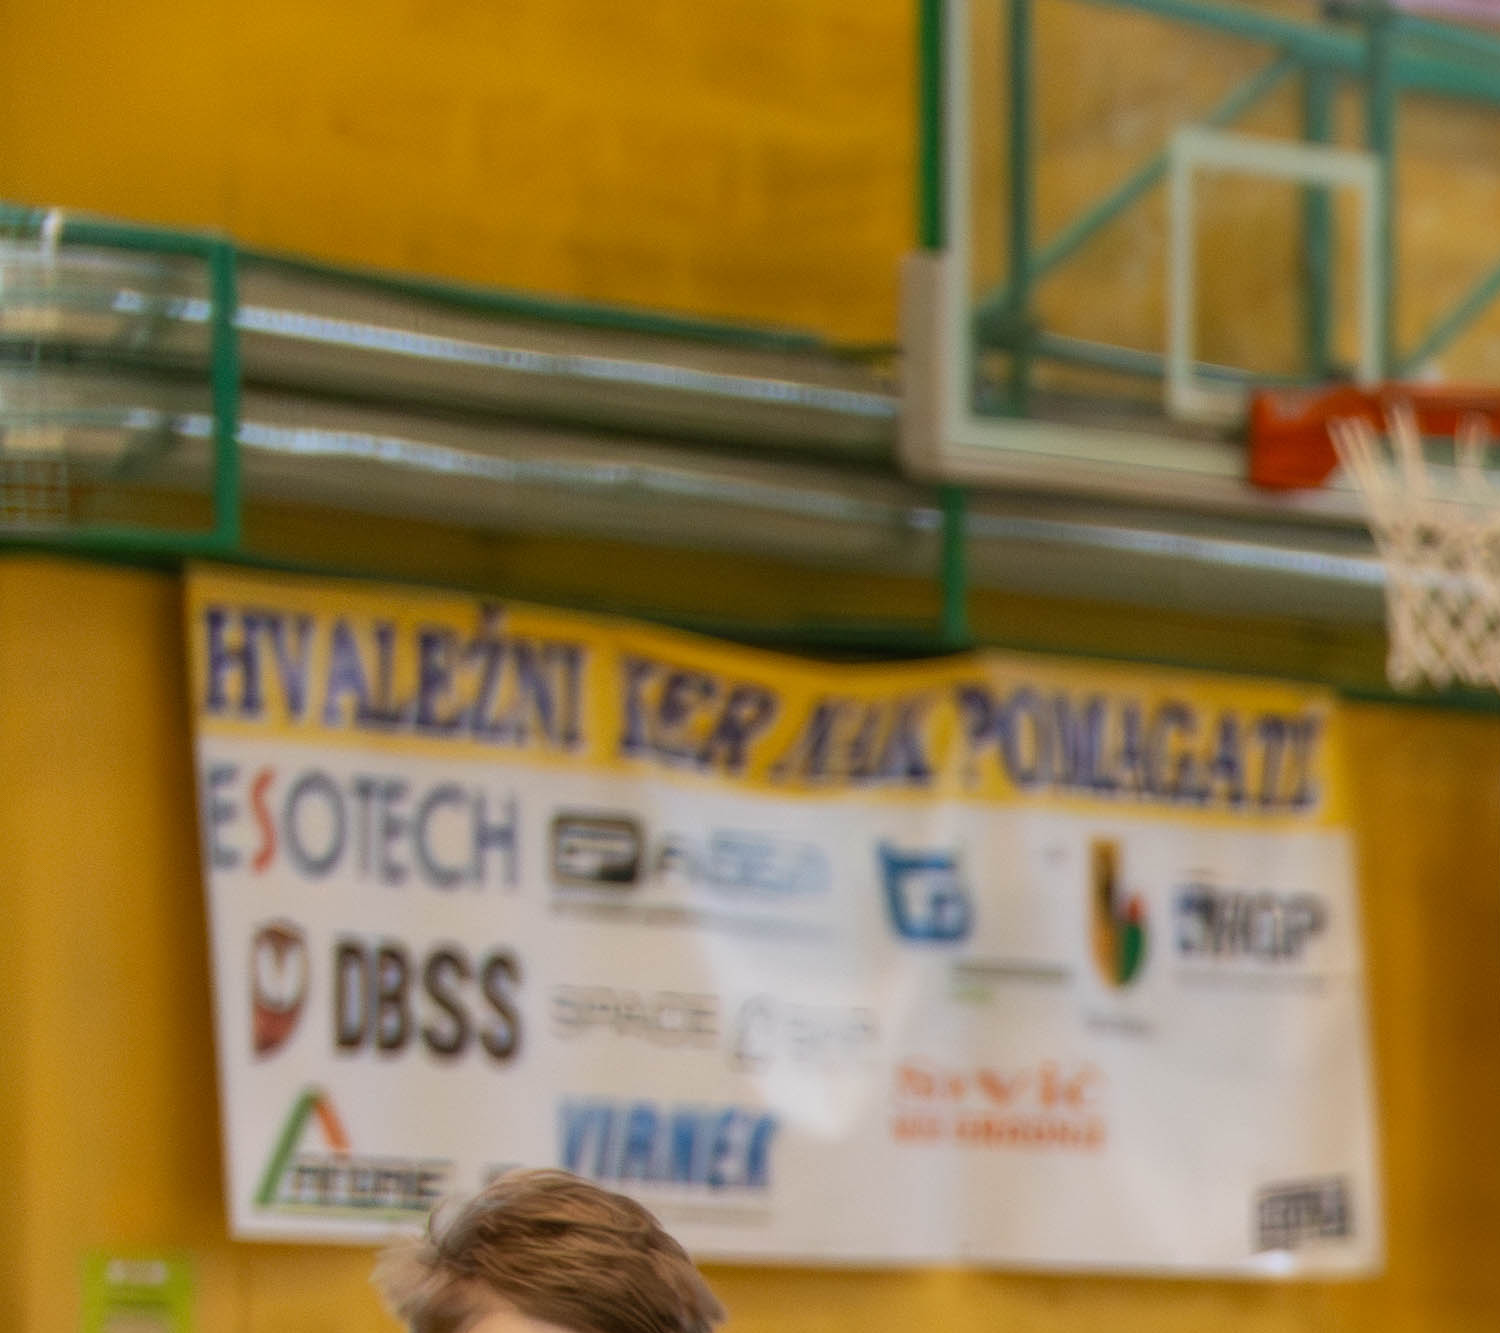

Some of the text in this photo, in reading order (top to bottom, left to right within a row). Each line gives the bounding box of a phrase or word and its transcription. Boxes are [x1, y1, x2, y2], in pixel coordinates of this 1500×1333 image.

[205, 604, 588, 757] HVALEŽNI
[207, 762, 520, 892] ESOTECH
[335, 940, 522, 1062] DBSS
